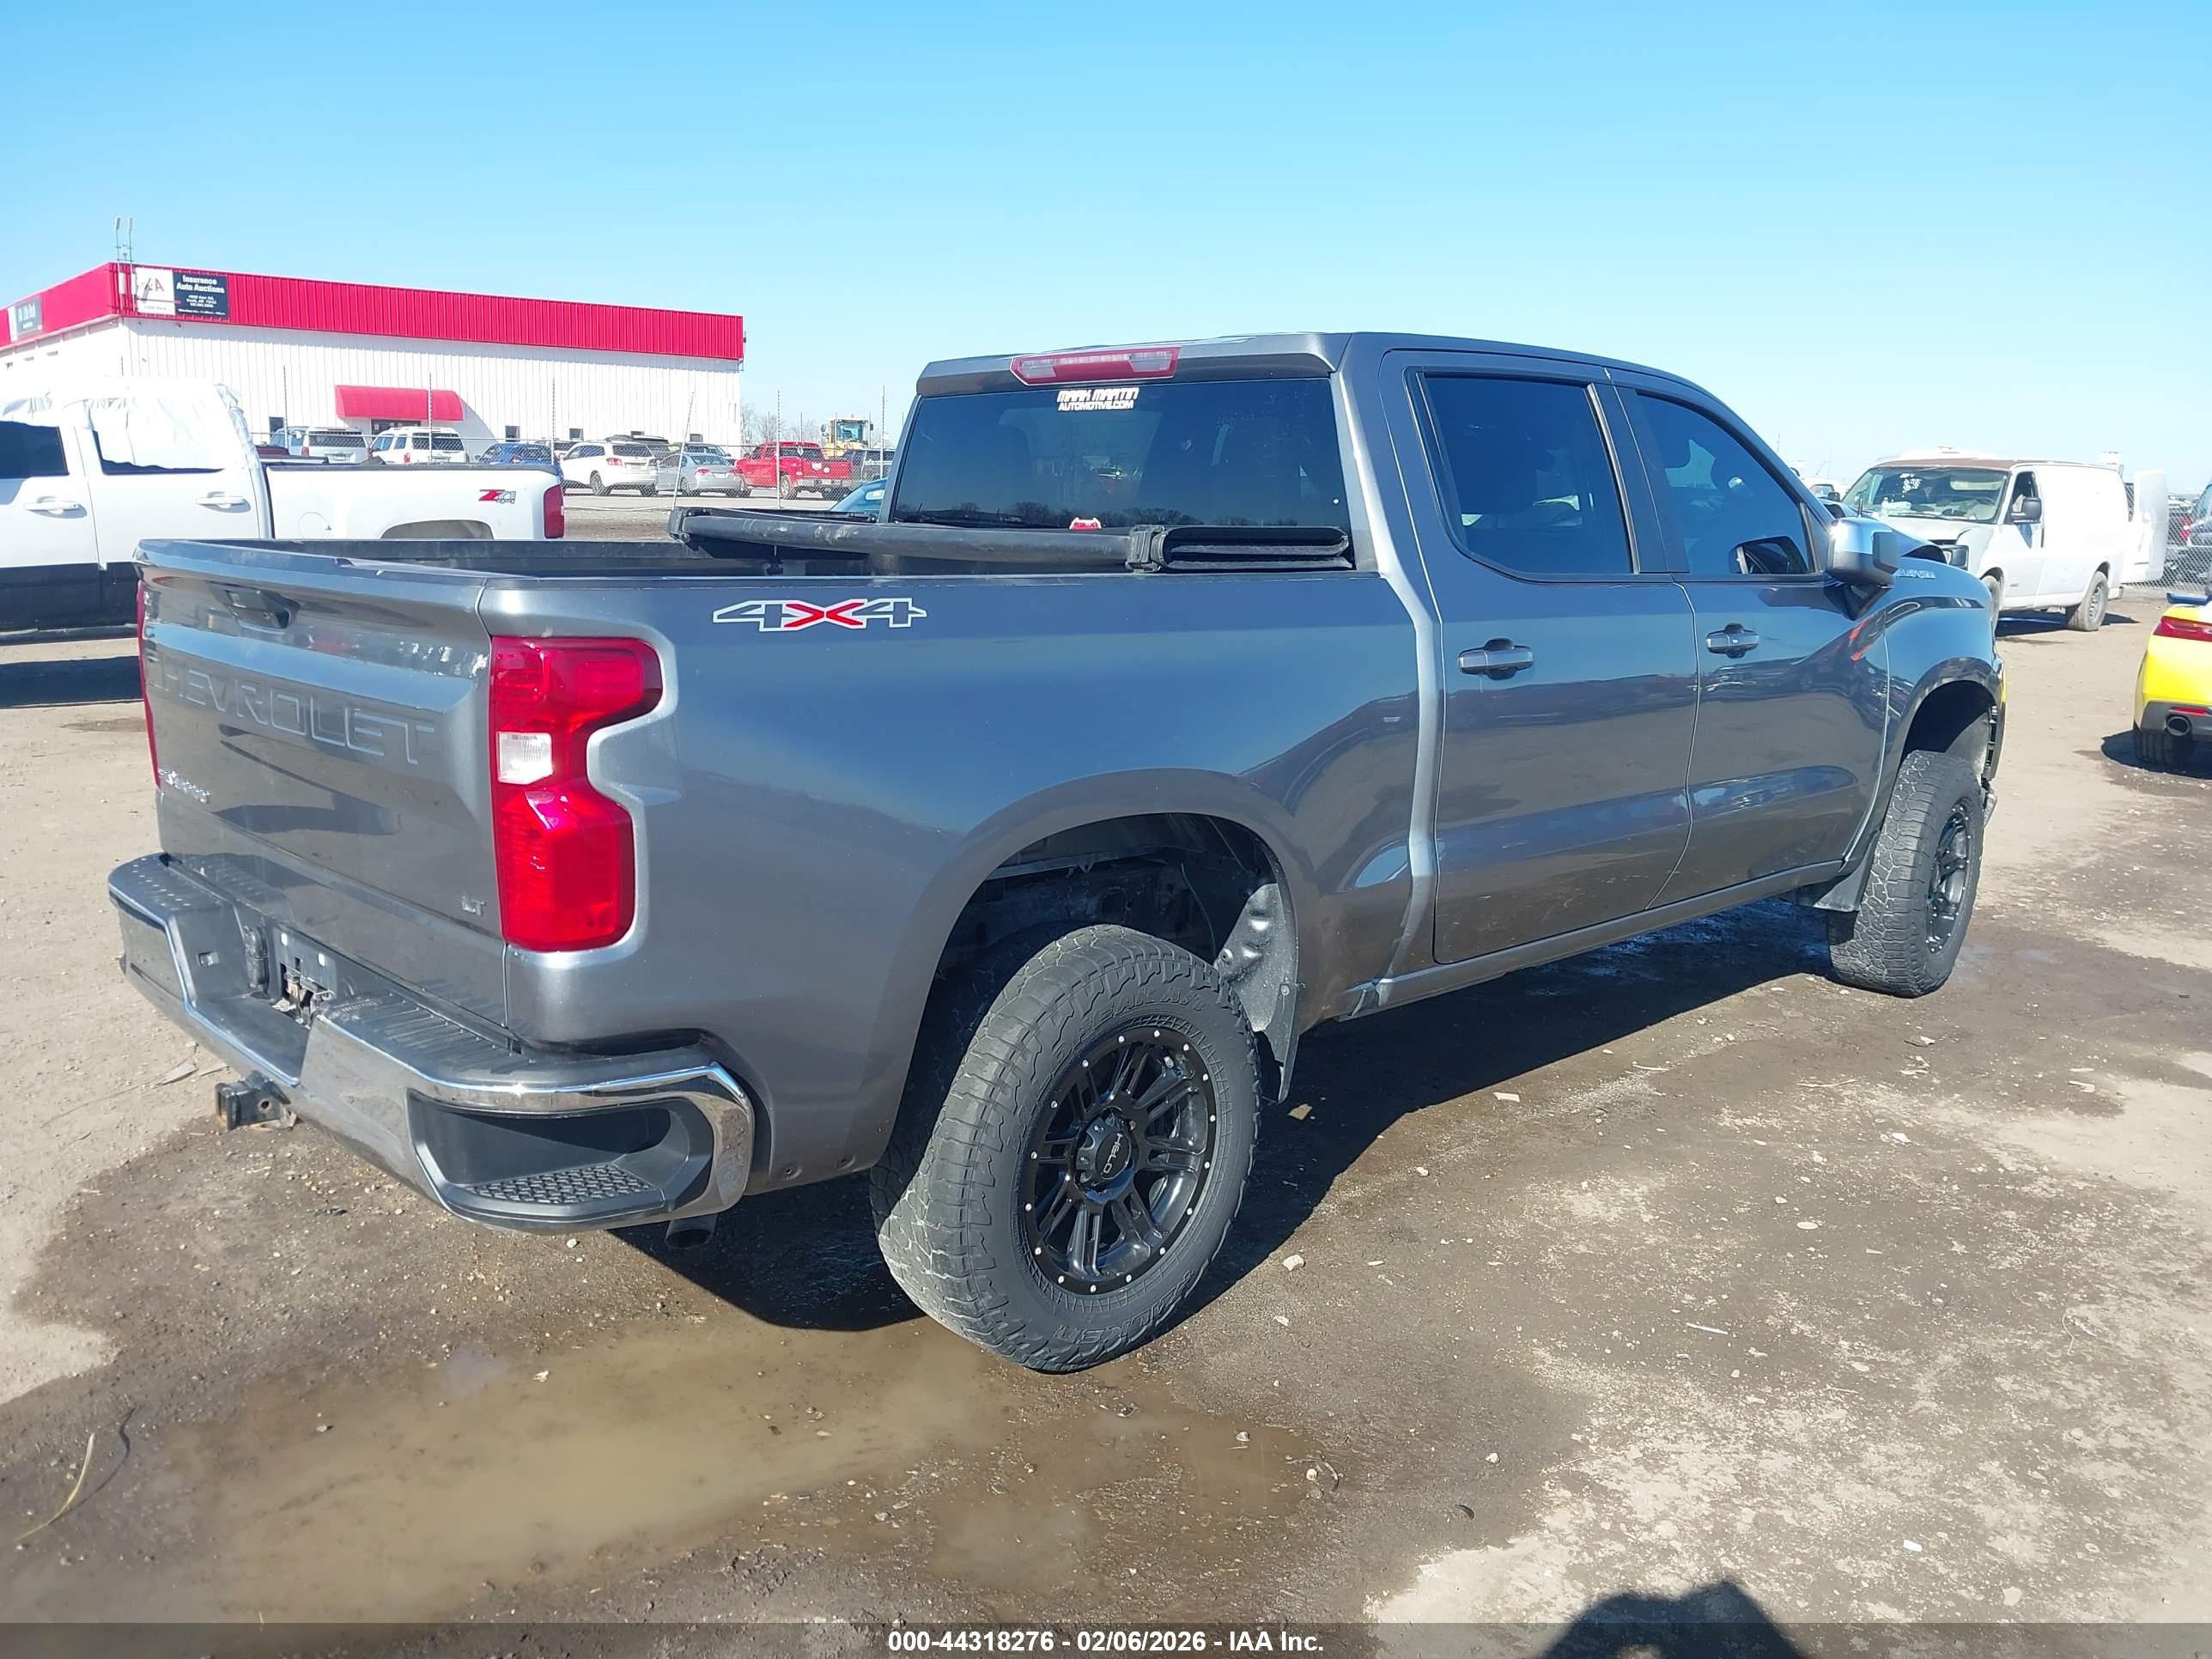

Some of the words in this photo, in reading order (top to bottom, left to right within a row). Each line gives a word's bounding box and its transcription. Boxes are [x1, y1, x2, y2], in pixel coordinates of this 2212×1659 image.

[182, 275, 217, 285] Insurance
[176, 282, 193, 291] Auto
[193, 283, 225, 294] Auctions
[1057, 389, 1092, 403] MARK
[1091, 387, 1139, 401] MARTIN
[1058, 399, 1134, 411] AUTOMOTIVE.COM
[460, 894, 488, 917] LT
[1103, 1133, 1123, 1175] HELO
